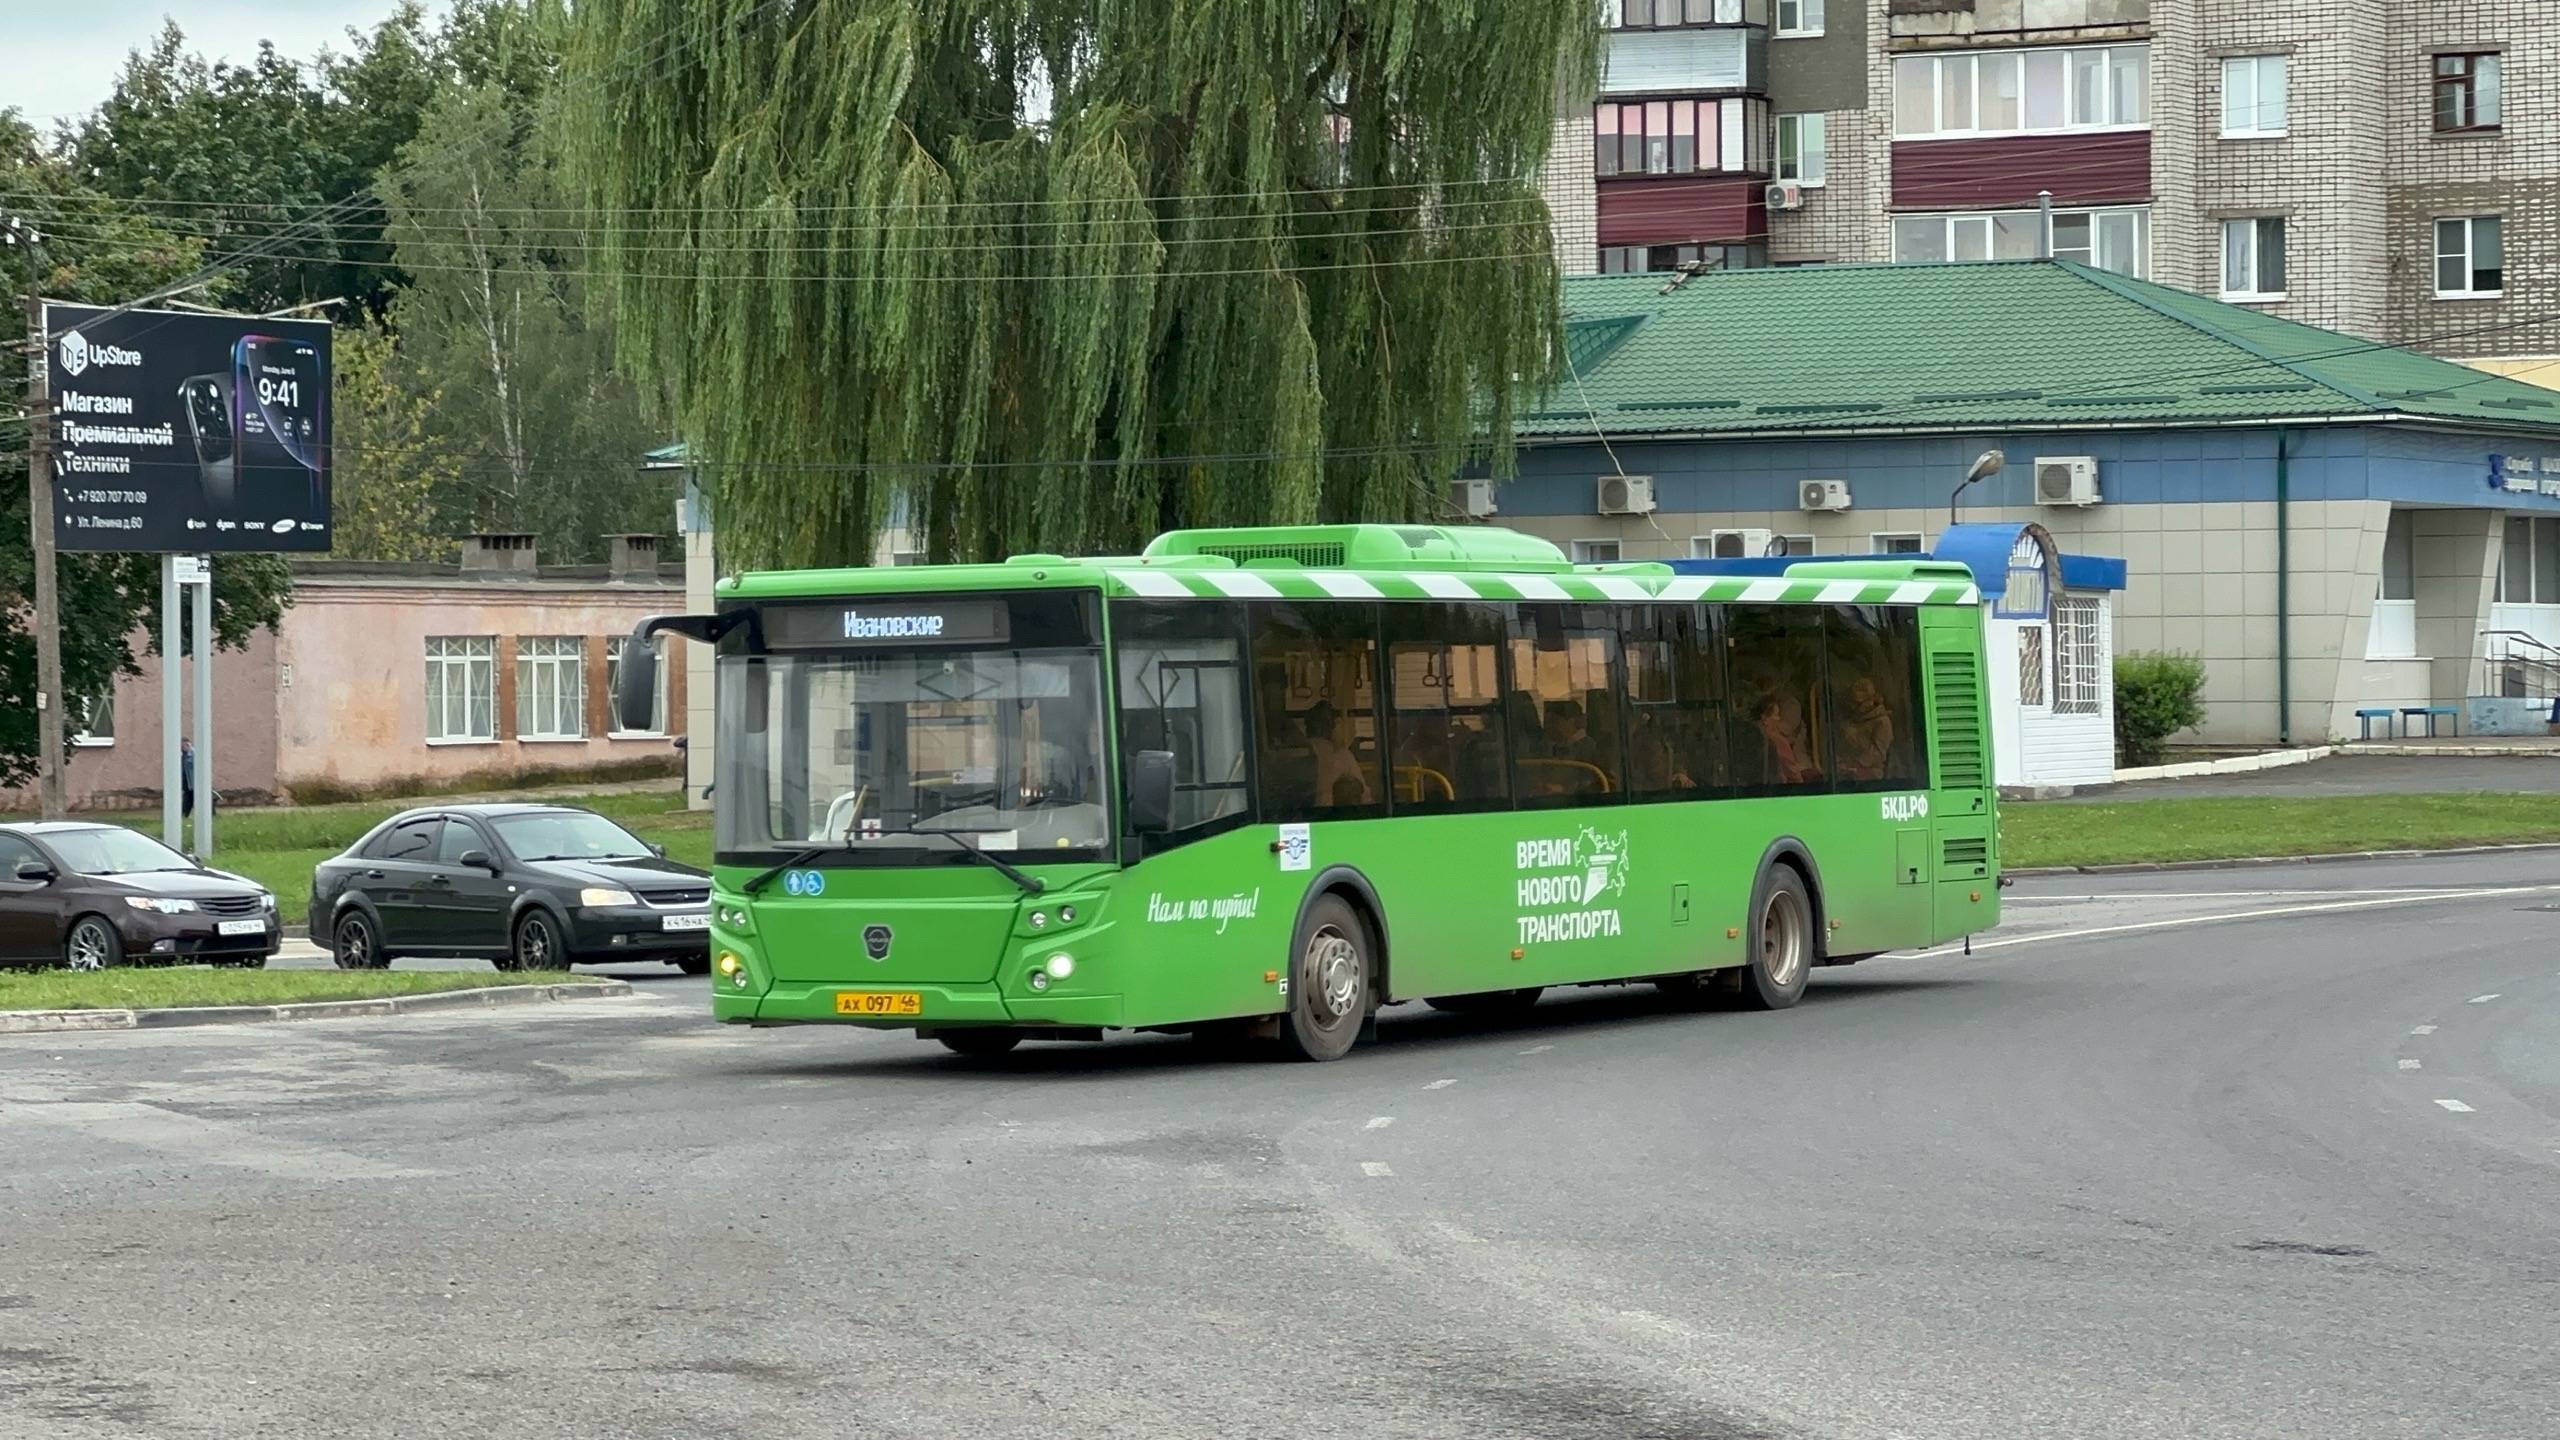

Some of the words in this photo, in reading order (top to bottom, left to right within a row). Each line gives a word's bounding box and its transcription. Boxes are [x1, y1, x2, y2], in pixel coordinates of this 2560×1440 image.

[89, 344, 142, 368] UpStore
[63, 391, 133, 414] Магазин
[258, 378, 298, 408] 9:41
[63, 420, 173, 446] Премиальной
[63, 451, 130, 473] Техники
[78, 490, 88, 502] +7
[89, 490, 106, 503] 920
[123, 491, 134, 503] 70
[844, 611, 943, 638] Ивановские
[1881, 794, 1928, 821] БКД.РФ
[1517, 838, 1571, 869] ВРЕМЯ
[1518, 875, 1581, 907] НОВОГО
[1147, 892, 1184, 922] Нам
[1188, 899, 1208, 920] по
[1211, 887, 1260, 935] пути!
[1517, 909, 1621, 944] ТРАНСПОРТА
[866, 995, 893, 1011] 097
[901, 995, 917, 1007] 46
